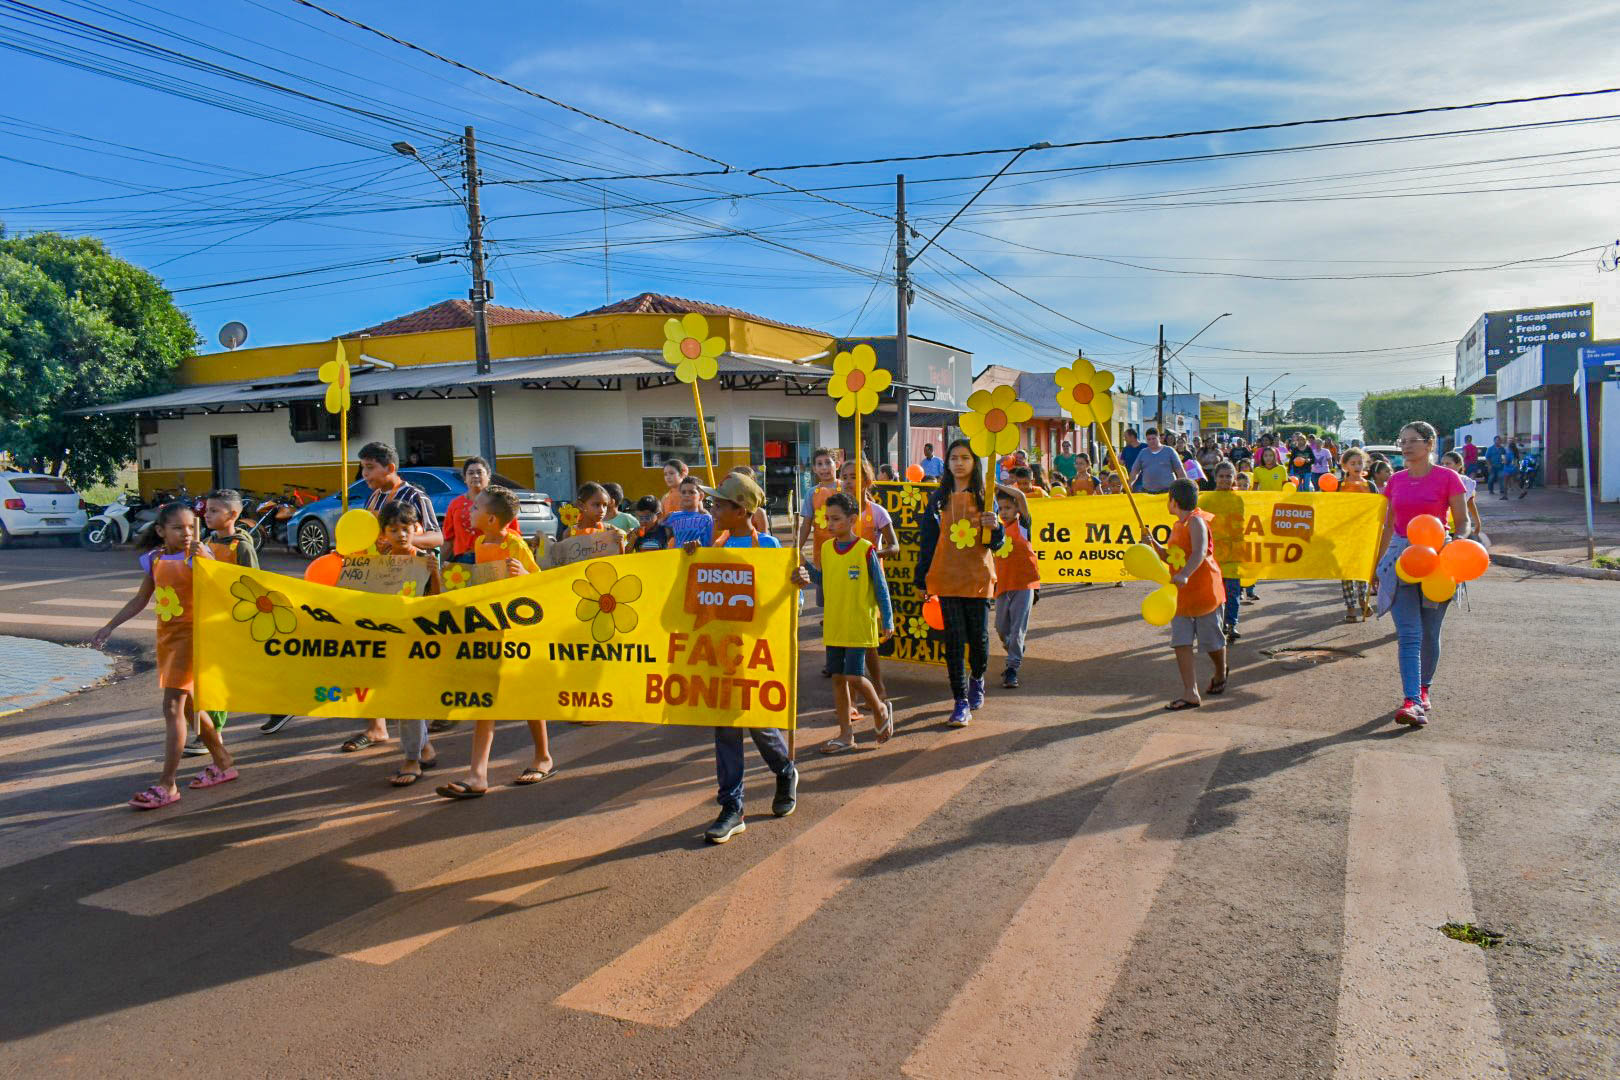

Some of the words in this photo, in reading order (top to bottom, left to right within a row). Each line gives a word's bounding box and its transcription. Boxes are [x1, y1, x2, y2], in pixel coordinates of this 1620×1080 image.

[1516, 334, 1546, 343] Troca
[1547, 332, 1560, 340] de
[1275, 509, 1313, 519] DISQUE
[1039, 522, 1071, 543] de
[1275, 520, 1292, 529] 100
[1053, 550, 1073, 561] AO
[1079, 550, 1125, 561] ABUSO
[696, 568, 753, 586] DISQUE
[1058, 568, 1092, 577] CRAS
[697, 591, 724, 606] 100
[412, 596, 544, 636] MAIO
[263, 638, 387, 659] COMBATE
[408, 641, 441, 660] AO
[455, 641, 531, 660] ABUSO
[549, 642, 657, 663] INFANTIL
[667, 632, 775, 675] FAÇA
[314, 685, 370, 703] SCFV
[440, 691, 494, 708] CRAS
[558, 690, 613, 708] SMAS
[645, 673, 787, 712] BONITO
